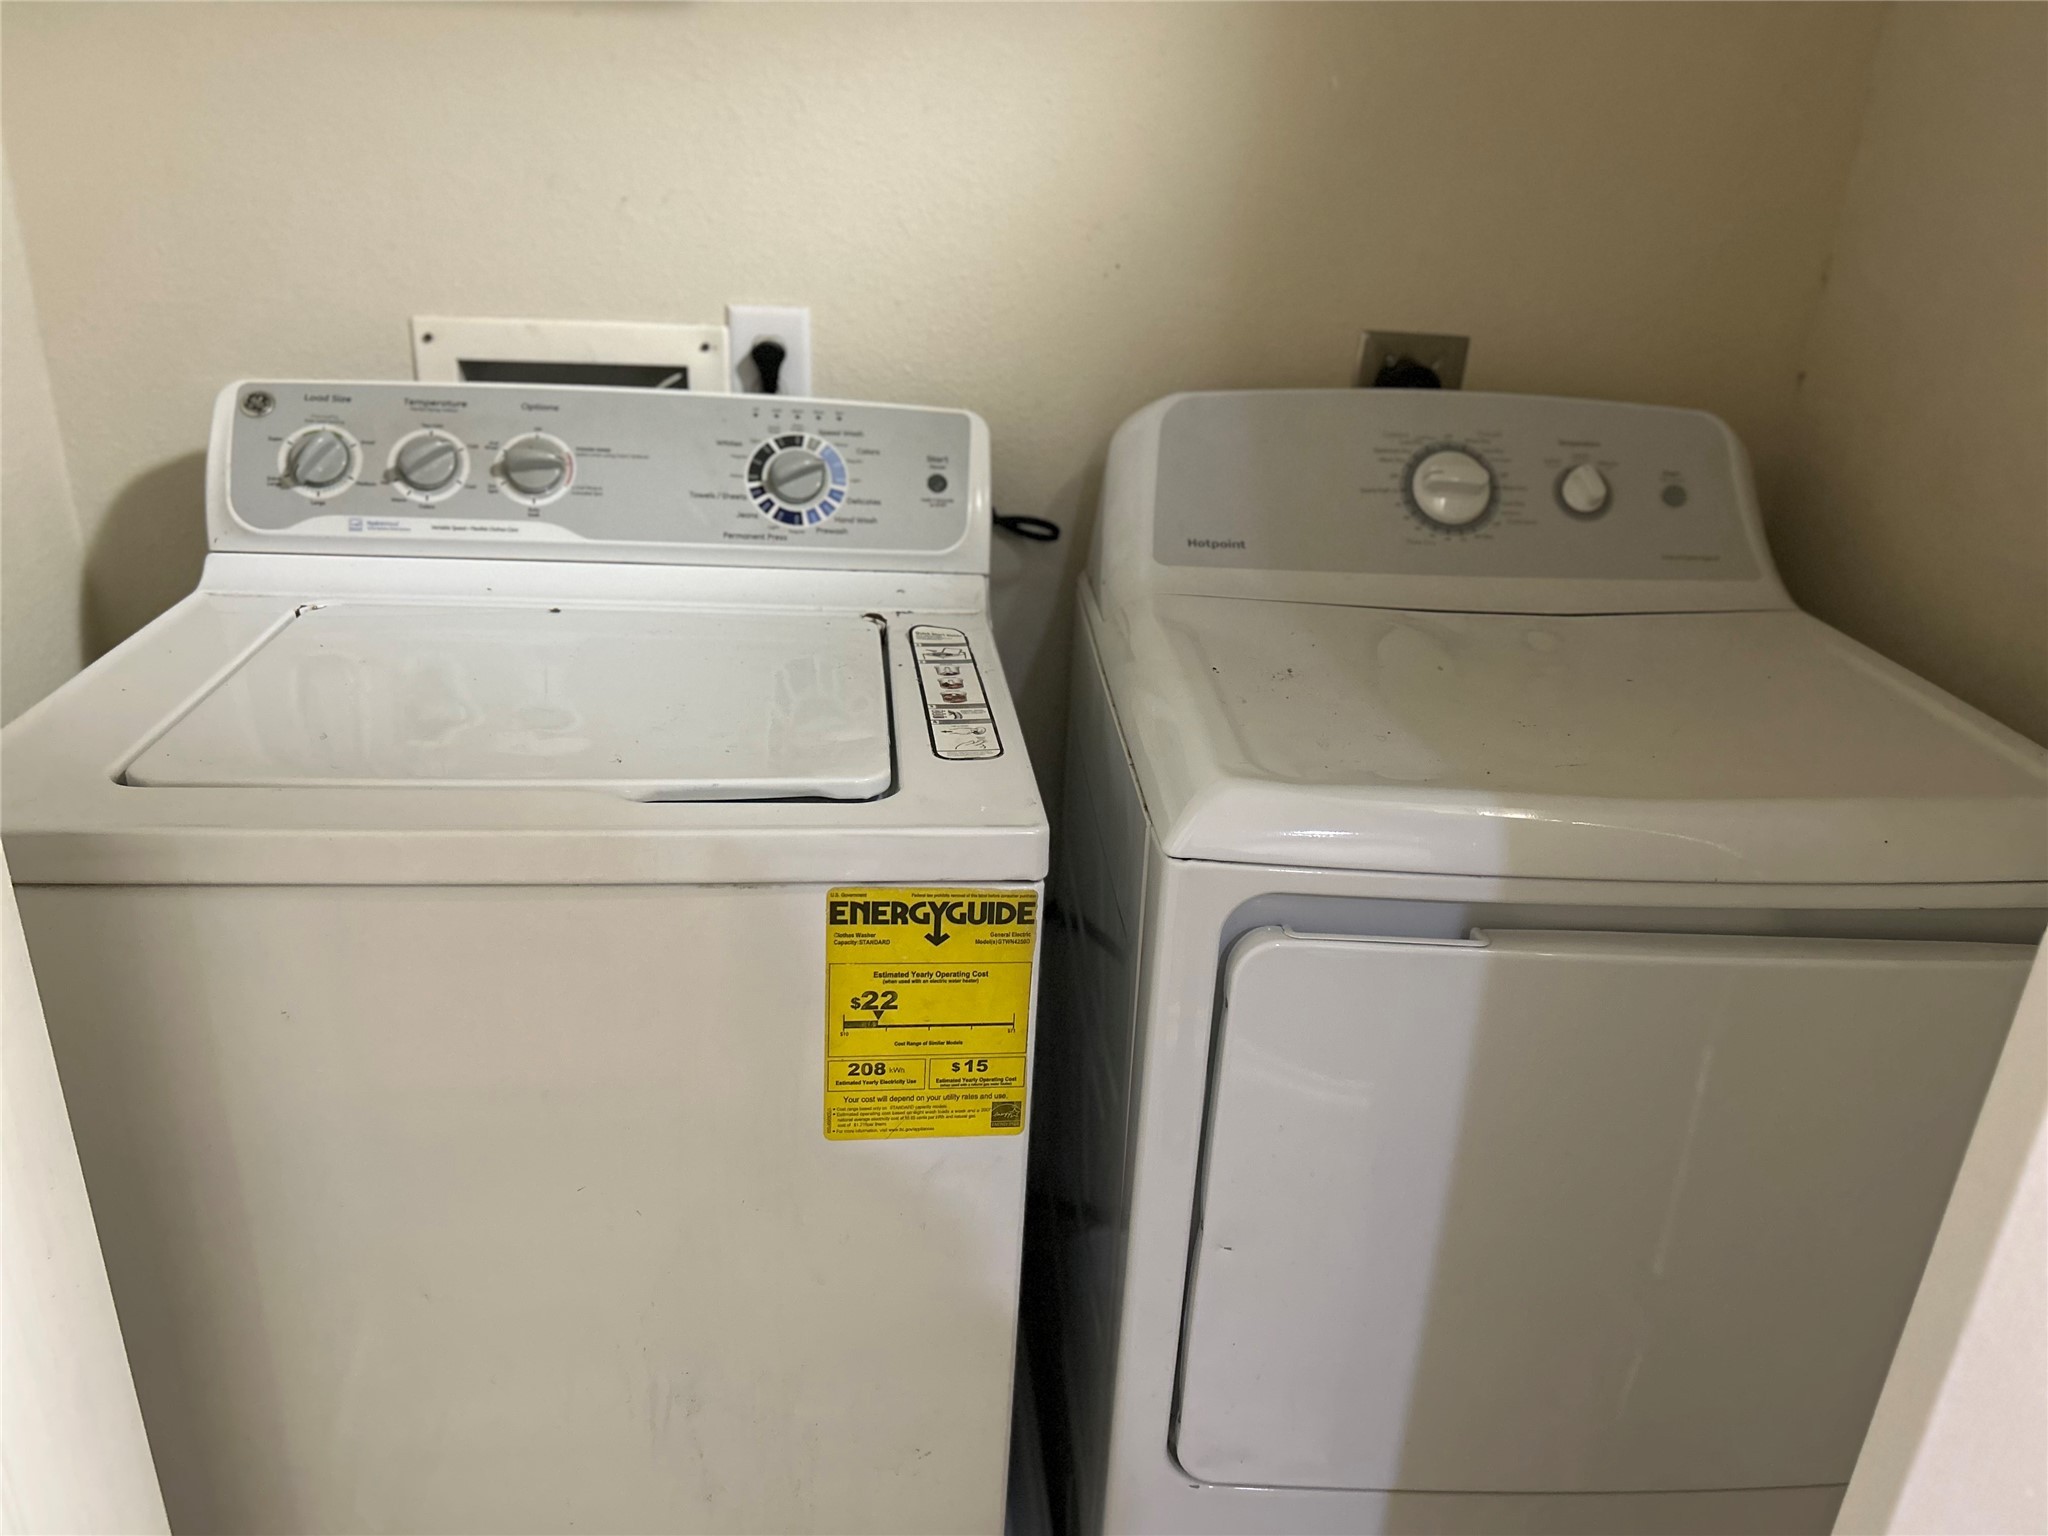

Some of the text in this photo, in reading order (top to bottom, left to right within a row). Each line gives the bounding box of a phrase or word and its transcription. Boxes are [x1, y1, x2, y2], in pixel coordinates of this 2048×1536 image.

[1187, 538, 1246, 549] Hotpoint
[911, 971, 933, 979] Yearly
[935, 971, 971, 979] Operating
[850, 990, 898, 1010] $22
[847, 1062, 886, 1076] 208
[889, 1095, 915, 1103] depend
[943, 1093, 961, 1101] utility
